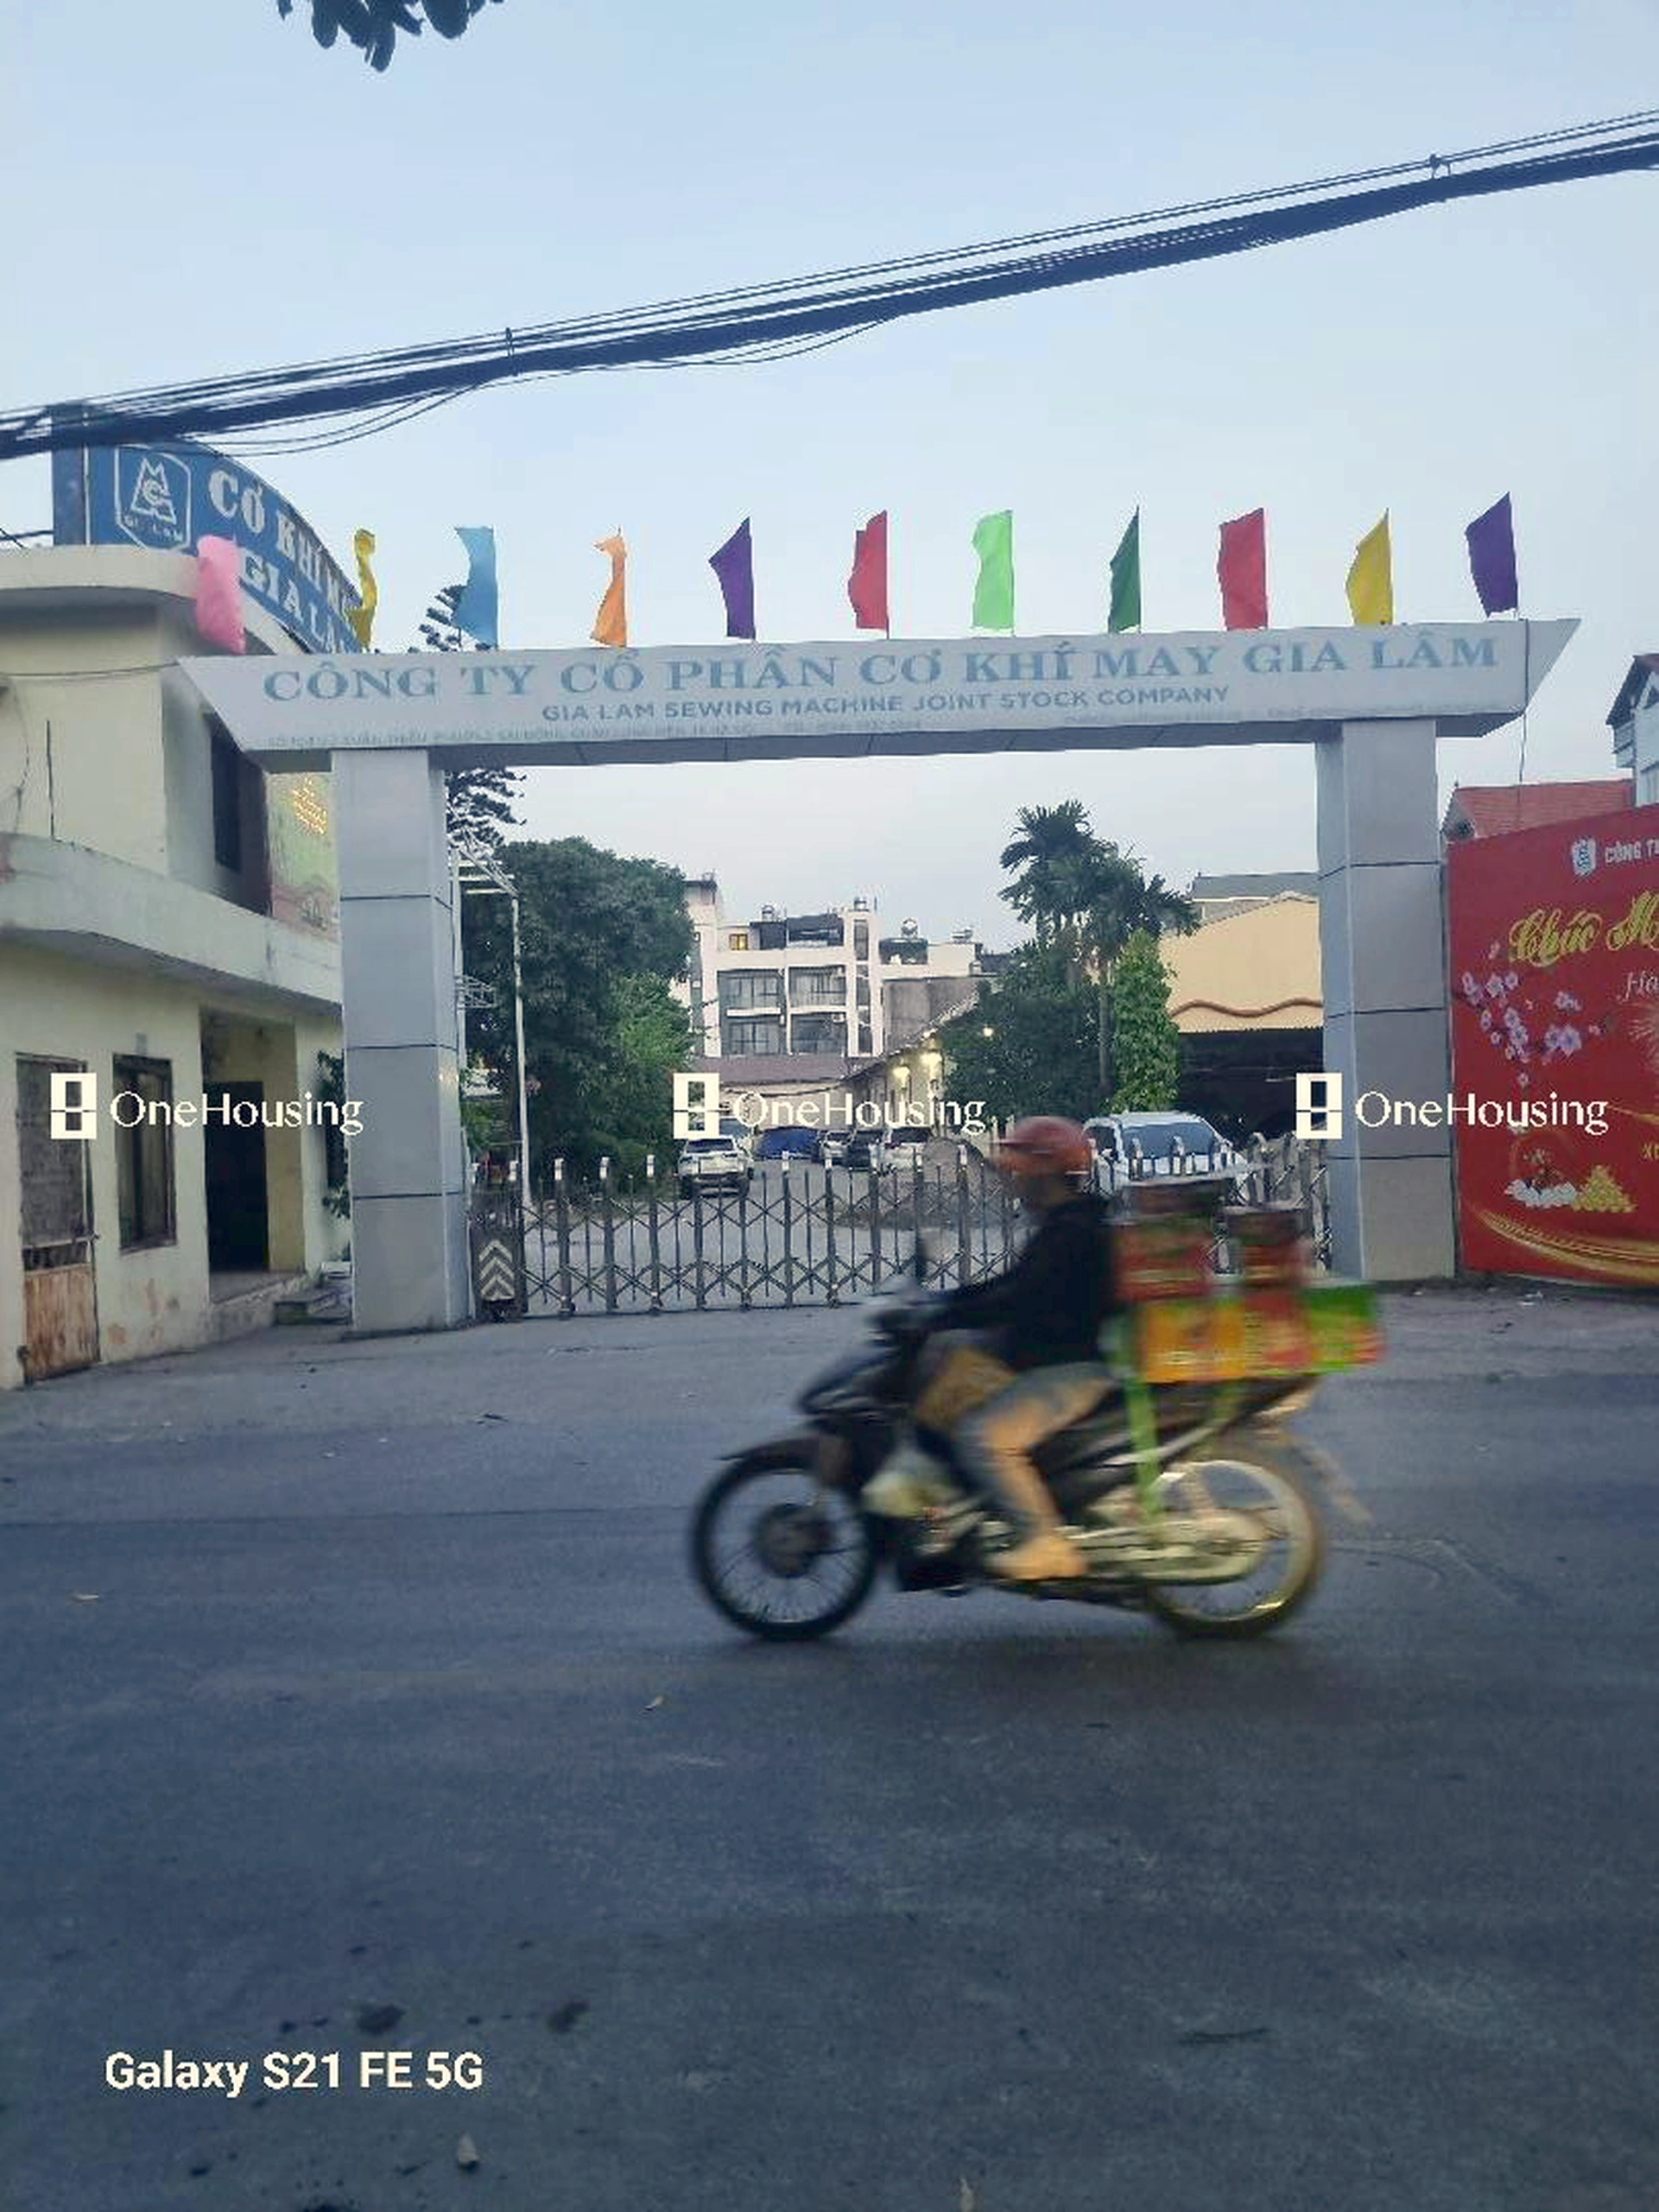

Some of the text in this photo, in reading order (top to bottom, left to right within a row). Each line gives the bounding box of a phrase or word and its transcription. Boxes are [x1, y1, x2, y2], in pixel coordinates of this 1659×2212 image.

[263, 661, 437, 701] CÔNG
[460, 663, 536, 696] TY
[859, 648, 942, 685] CƠ
[962, 641, 1079, 683] KHÍ
[1093, 644, 1220, 681] MAY
[1242, 639, 1346, 673] GIA
[1370, 630, 1499, 669] LÂM
[542, 687, 1230, 721] GIA LAM SEWING MACHINE JOINT STOCK COMPANY
